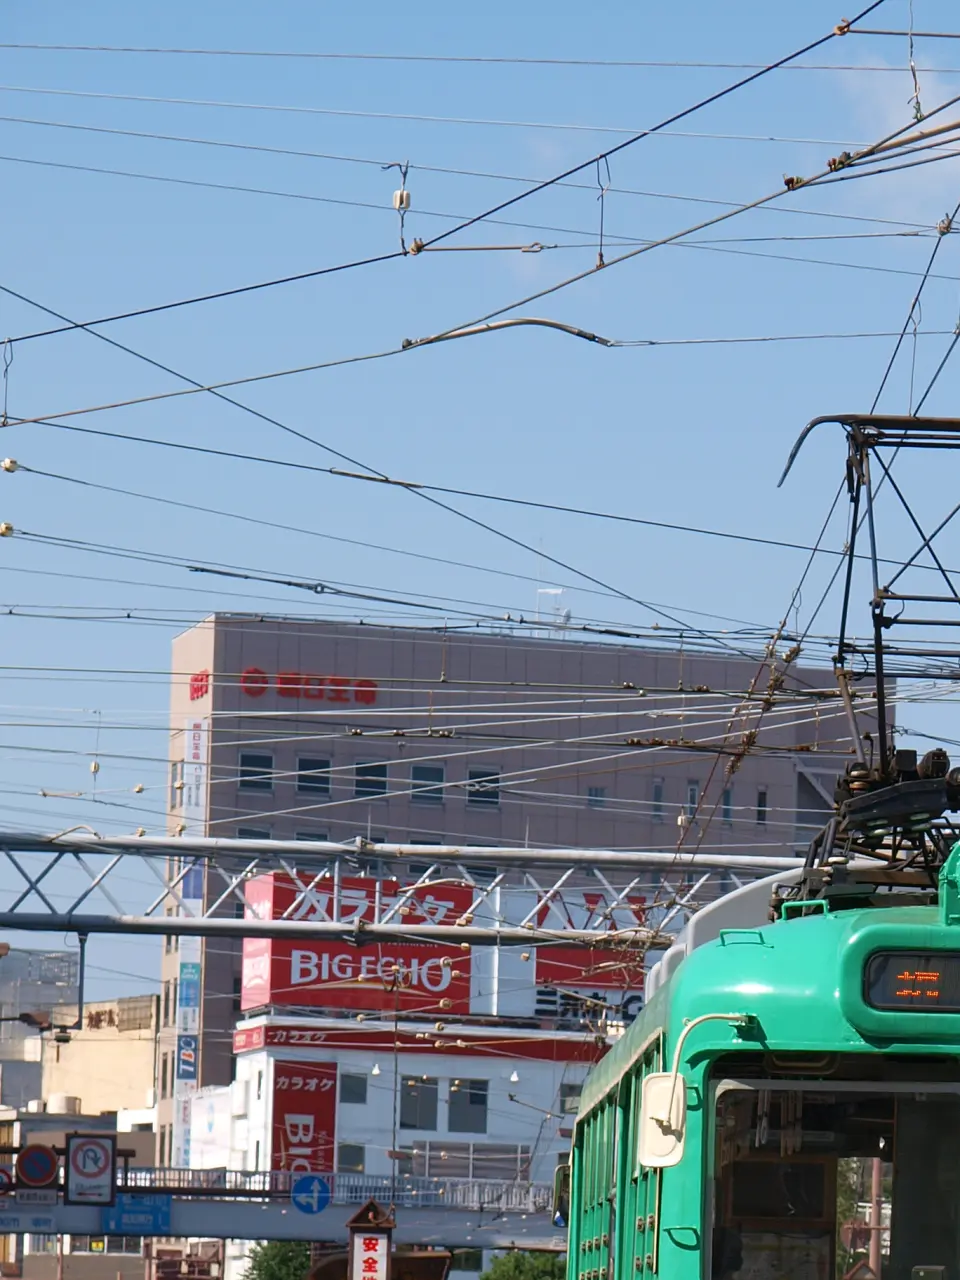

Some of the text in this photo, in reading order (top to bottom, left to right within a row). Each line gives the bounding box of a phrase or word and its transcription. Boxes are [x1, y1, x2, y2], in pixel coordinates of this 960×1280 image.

[293, 888, 454, 926] カラオケ
[290, 949, 451, 992] BIG ECHO
[275, 1076, 335, 1092] カラオケ
